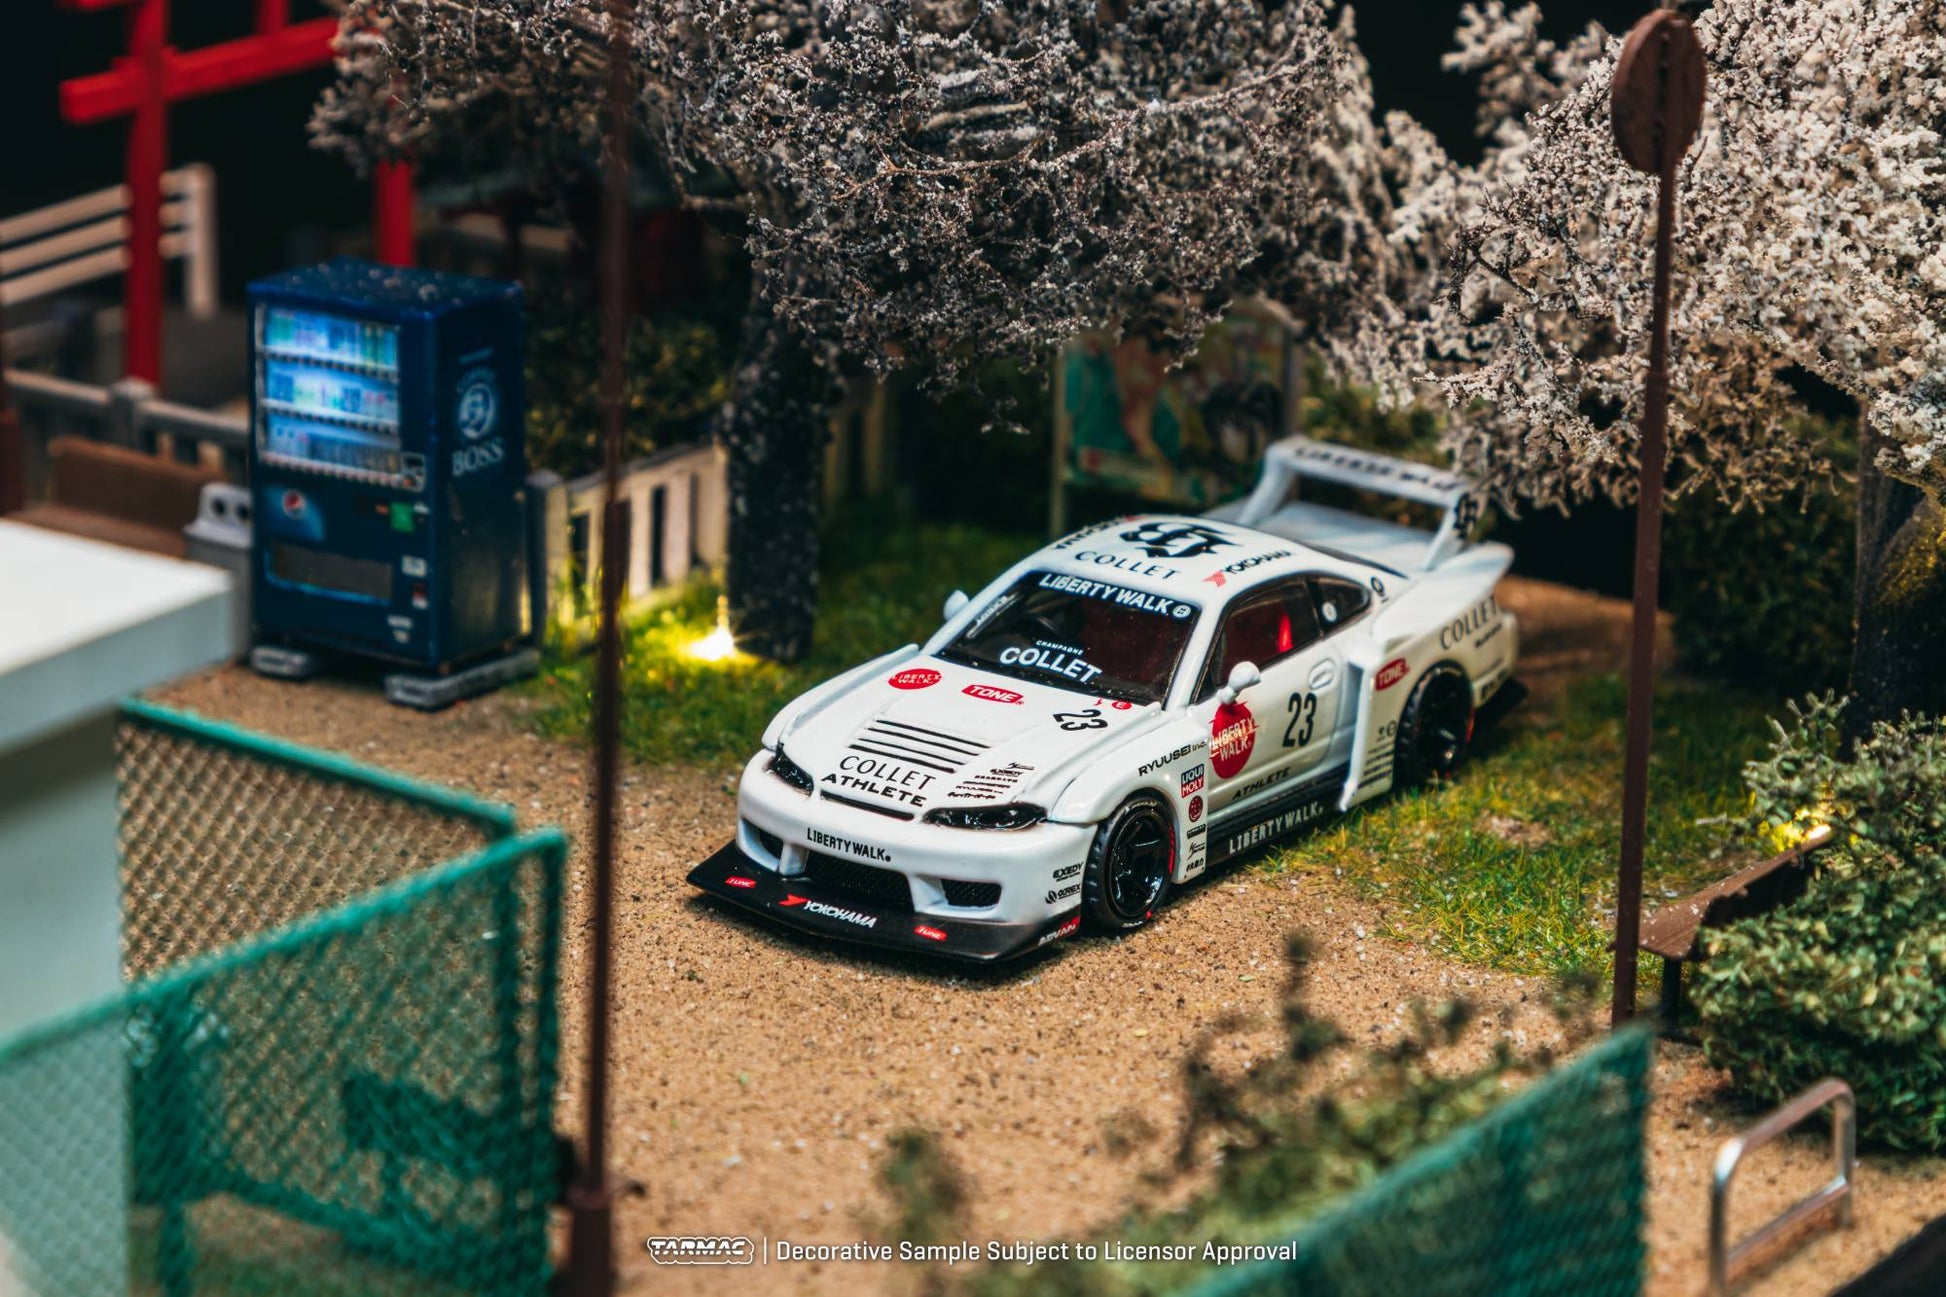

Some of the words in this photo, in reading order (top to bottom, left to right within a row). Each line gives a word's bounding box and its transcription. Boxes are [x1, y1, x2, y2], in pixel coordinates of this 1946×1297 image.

[452, 438, 503, 477] BOSS
[1075, 550, 1181, 580] COLLET
[1038, 573, 1118, 600] LIBERTY
[1116, 589, 1174, 615] WALK
[1440, 593, 1498, 651] COLLET
[1000, 646, 1102, 683] COLLET
[1036, 639, 1085, 656] CHAMPAGNE
[969, 685, 1019, 701] TONE
[1052, 708, 1109, 732] 23
[1210, 717, 1257, 755] LIBERTY
[1282, 691, 1318, 748] 23
[1219, 735, 1249, 761] WALK
[839, 755, 936, 790] COLLET
[1181, 778, 1204, 797] MOLY
[1232, 766, 1292, 801] ATHLETE
[821, 773, 927, 808] ATHLETE
[807, 827, 852, 852] LIBERTY
[1229, 817, 1283, 855] LIBERTY
[1284, 801, 1319, 829] WALK
[1053, 861, 1084, 879] EXEDY
[803, 899, 877, 929] YOKOHAMA
